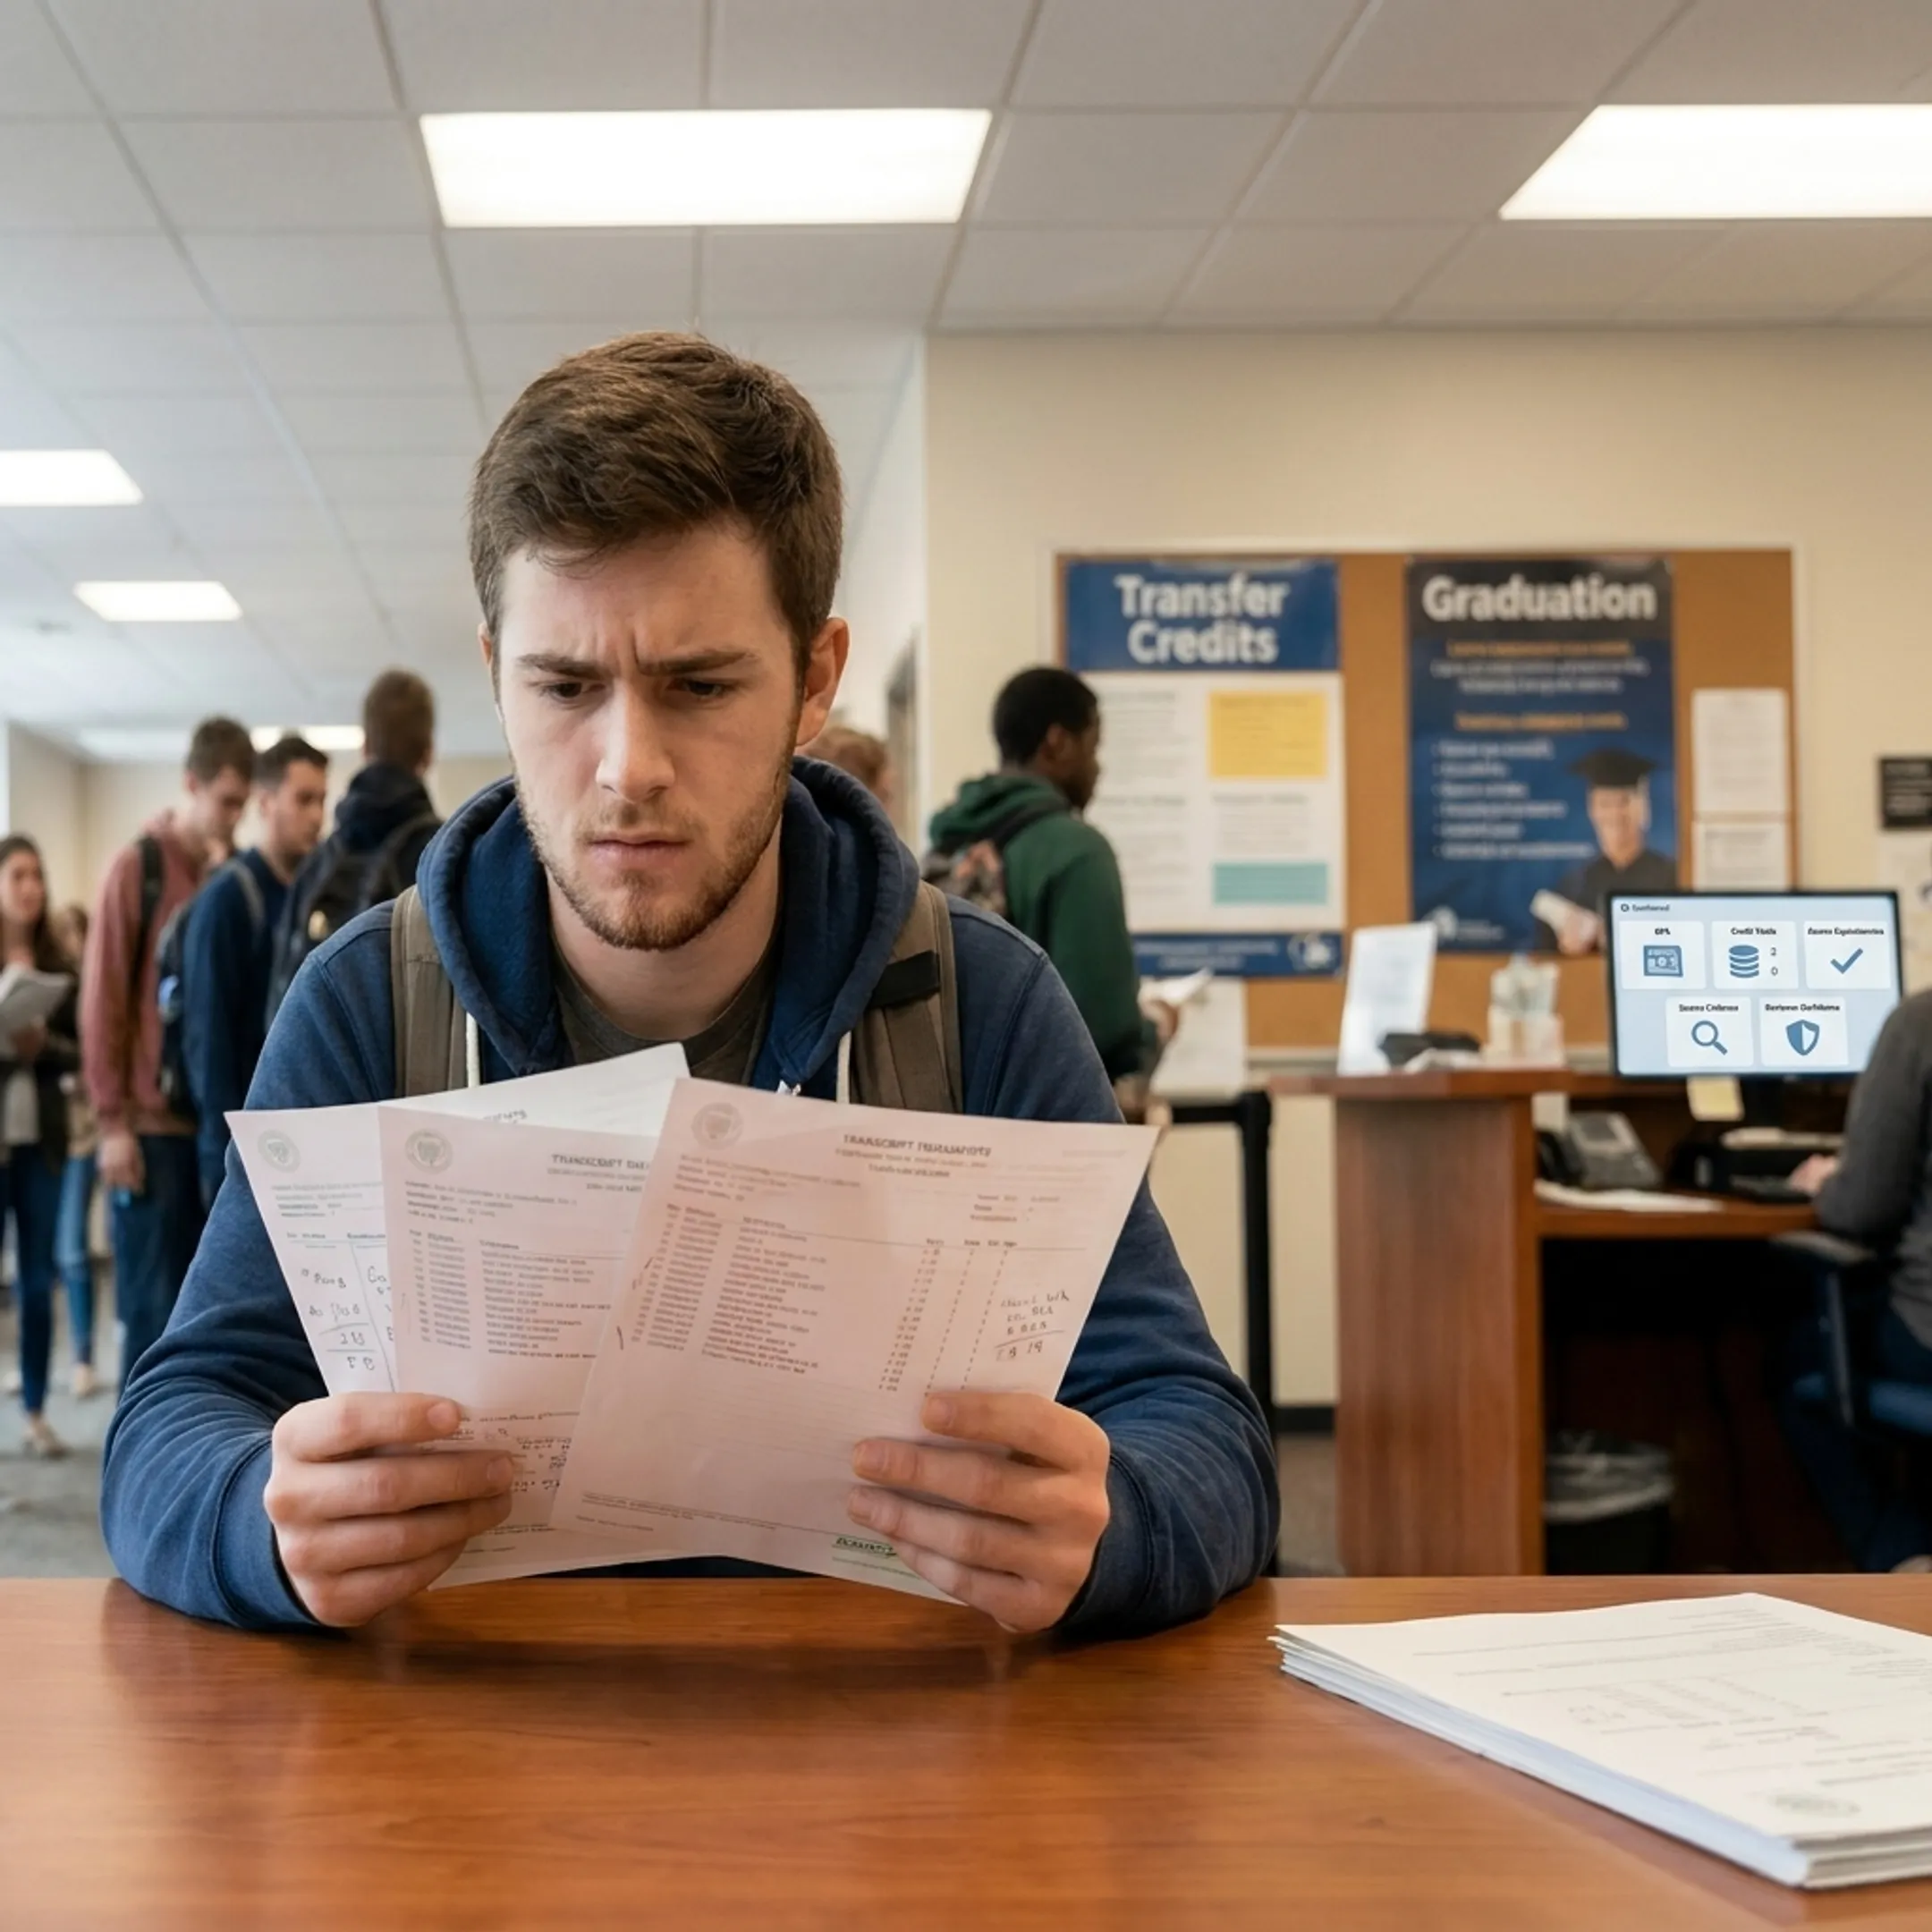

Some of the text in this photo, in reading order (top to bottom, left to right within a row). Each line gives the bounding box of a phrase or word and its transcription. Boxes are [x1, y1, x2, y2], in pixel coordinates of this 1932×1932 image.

[1114, 572, 1289, 617] Transfer
[1422, 573, 1657, 621] Graduation
[1128, 620, 1278, 663] Credits
